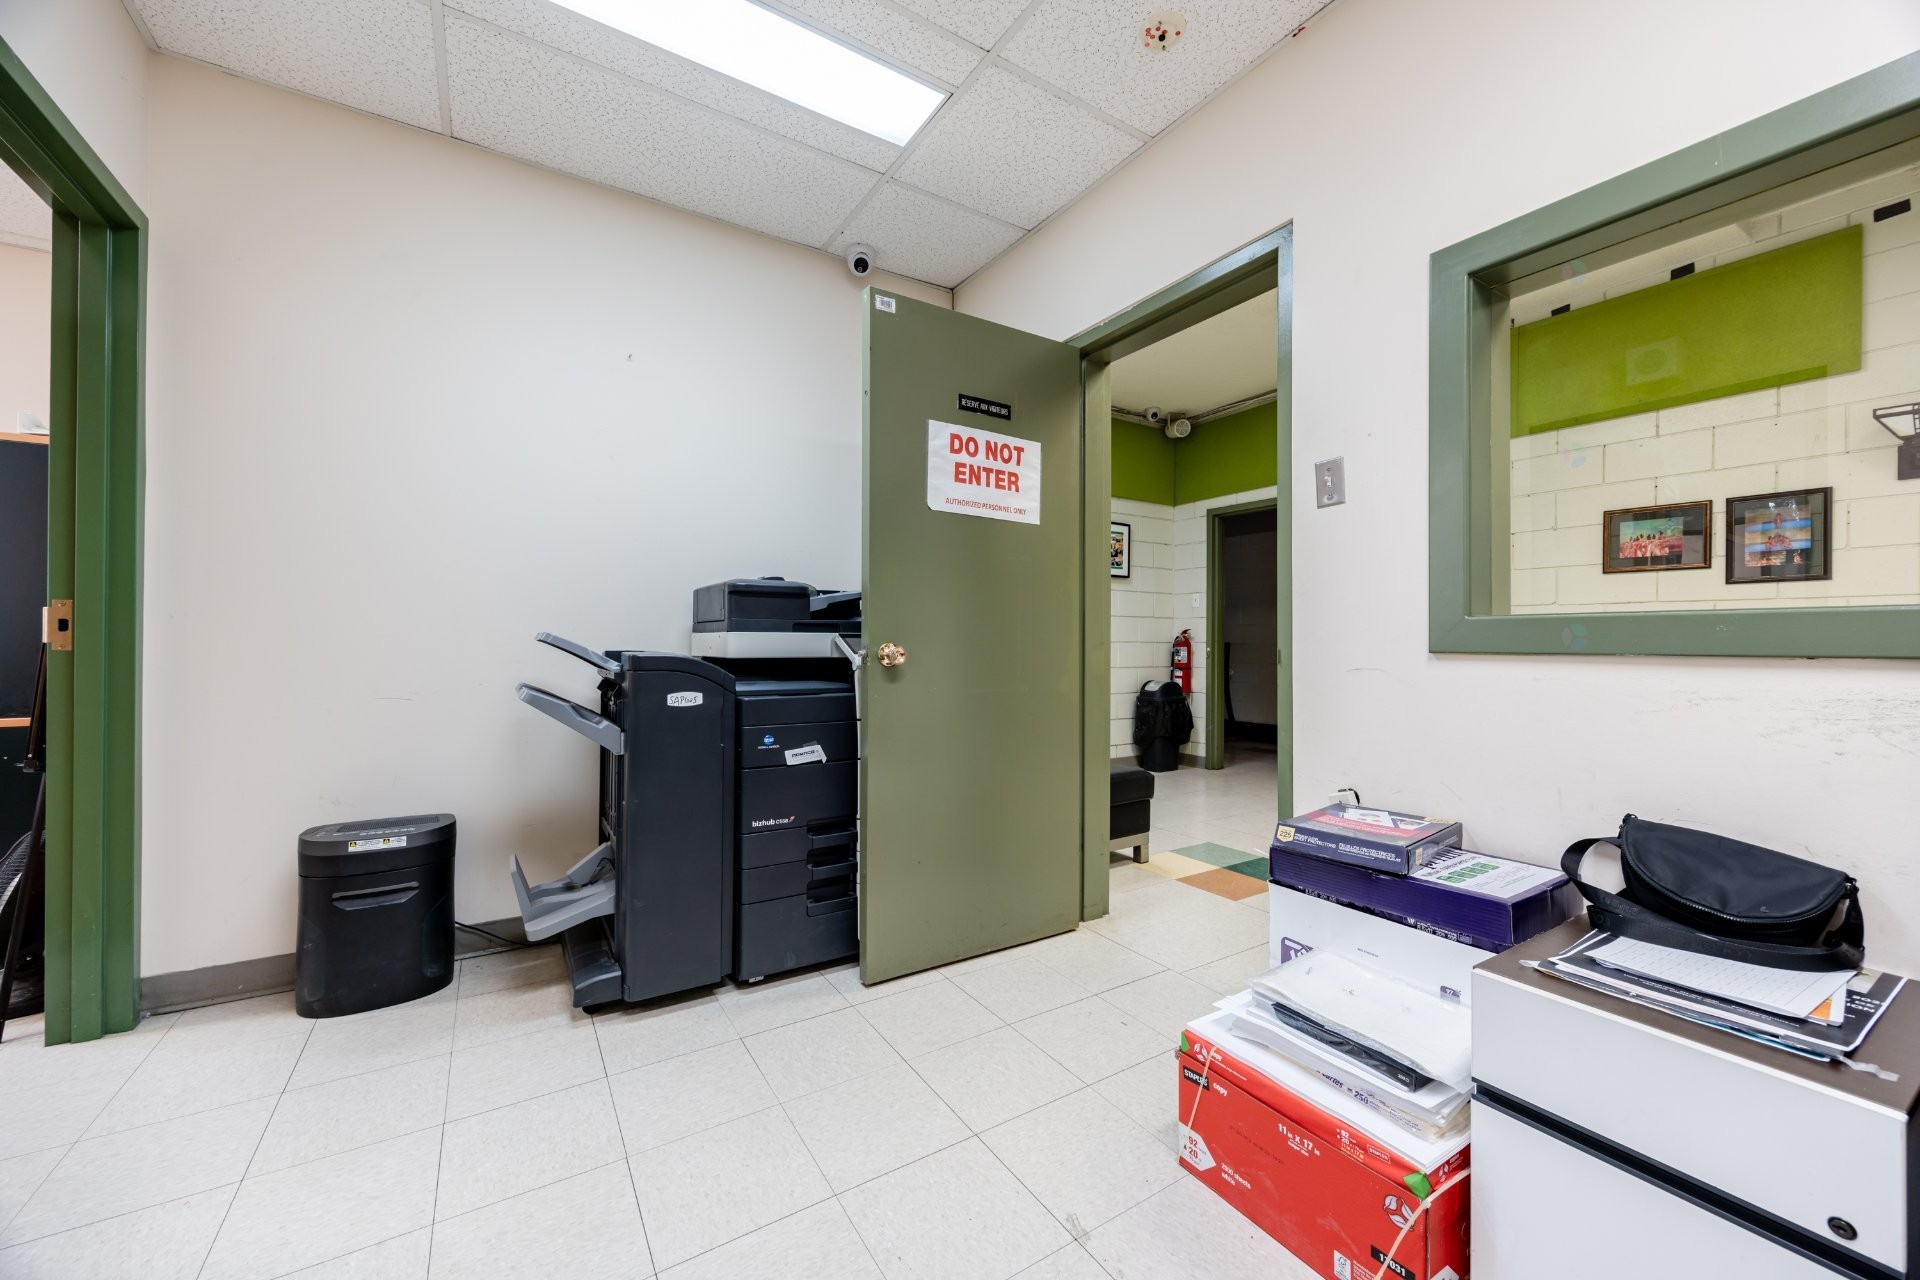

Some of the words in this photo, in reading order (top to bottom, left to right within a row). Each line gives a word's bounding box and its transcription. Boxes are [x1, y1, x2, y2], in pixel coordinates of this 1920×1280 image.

[949, 432, 979, 458] DO
[985, 439, 1025, 467] NOT
[954, 461, 1020, 493] ENTER
[945, 497, 981, 509] AUTHORIZED
[981, 502, 1013, 514] PERSONNEL
[1013, 508, 1027, 516] ONLY
[752, 818, 775, 827] bizhub
[1279, 829, 1292, 839] 225
[1213, 1082, 1228, 1097] copy
[1354, 1090, 1369, 1105] 250
[1188, 1135, 1198, 1149] 92
[1278, 1122, 1287, 1136] 11
[1303, 1138, 1313, 1151] 17
[1189, 1146, 1198, 1159] 20
[1221, 1171, 1236, 1186] white
[1234, 1173, 1251, 1190] sheets
[1379, 1252, 1406, 1277] 1031
